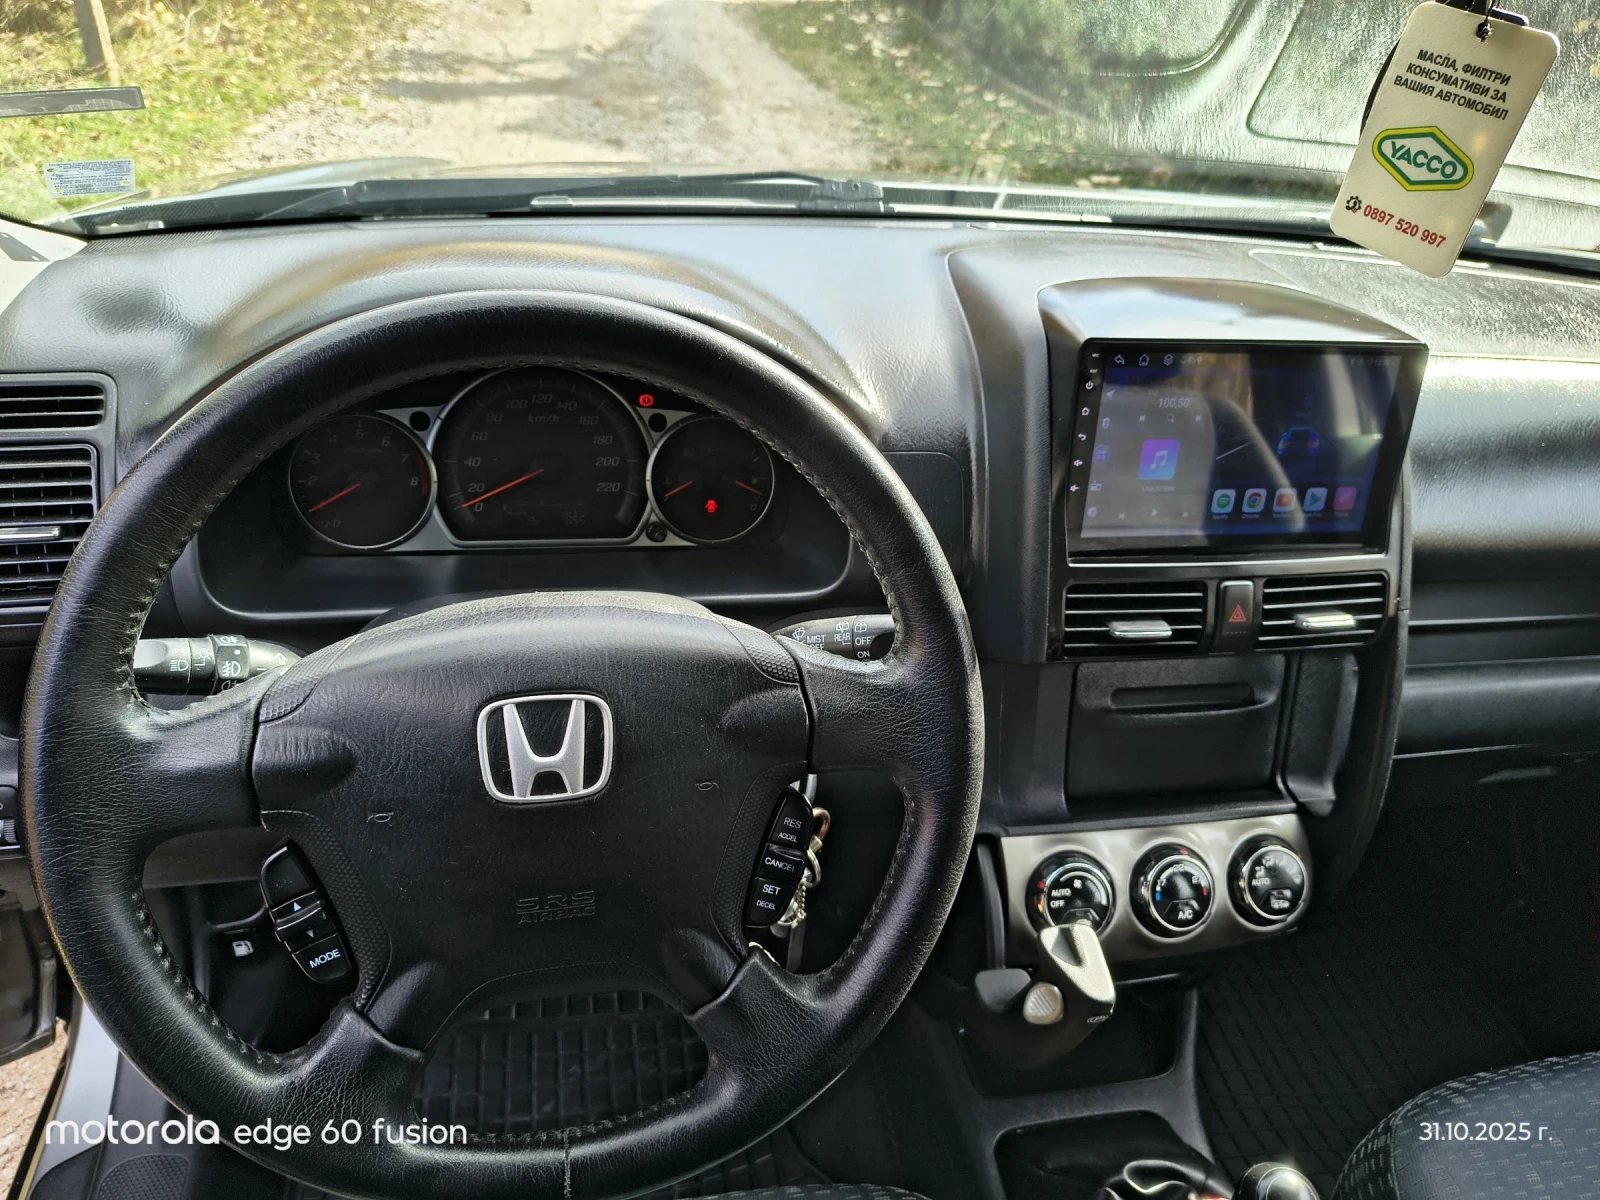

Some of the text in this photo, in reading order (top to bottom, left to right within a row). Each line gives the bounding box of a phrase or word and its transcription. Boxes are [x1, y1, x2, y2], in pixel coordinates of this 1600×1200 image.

[1417, 49, 1511, 86] МАСЛА, ФИЛТРИ
[1406, 63, 1507, 103] КОНСУМАТИВИ ЗА
[1394, 76, 1509, 120] ВАШИЯ АВТОМОБИЛ
[1390, 141, 1458, 179] YACCO
[1363, 204, 1447, 249] 0897 520 997
[532, 394, 553, 404] 120
[506, 400, 527, 410] 100
[556, 401, 577, 411] 140
[485, 413, 503, 423] 80
[527, 413, 560, 423] km/h
[579, 416, 598, 426] 160
[471, 431, 488, 441] 60
[593, 435, 613, 445] 180
[464, 457, 481, 467] 40
[595, 457, 619, 467] 200
[410, 477, 419, 486] 8
[468, 483, 485, 493] 20
[596, 482, 620, 492] 220
[474, 503, 484, 512] 0
[807, 635, 826, 644] MIST
[834, 633, 851, 642] REAR
[855, 636, 871, 646] OFF
[857, 651, 870, 659] ON
[783, 817, 802, 829] RES
[778, 832, 798, 842] ACCEL
[762, 884, 781, 895] SET
[1051, 888, 1071, 897] AUTO
[756, 900, 776, 911] DECEL
[1050, 900, 1065, 909] OFF
[1178, 910, 1194, 920] A/C
[309, 949, 342, 968] MODE
